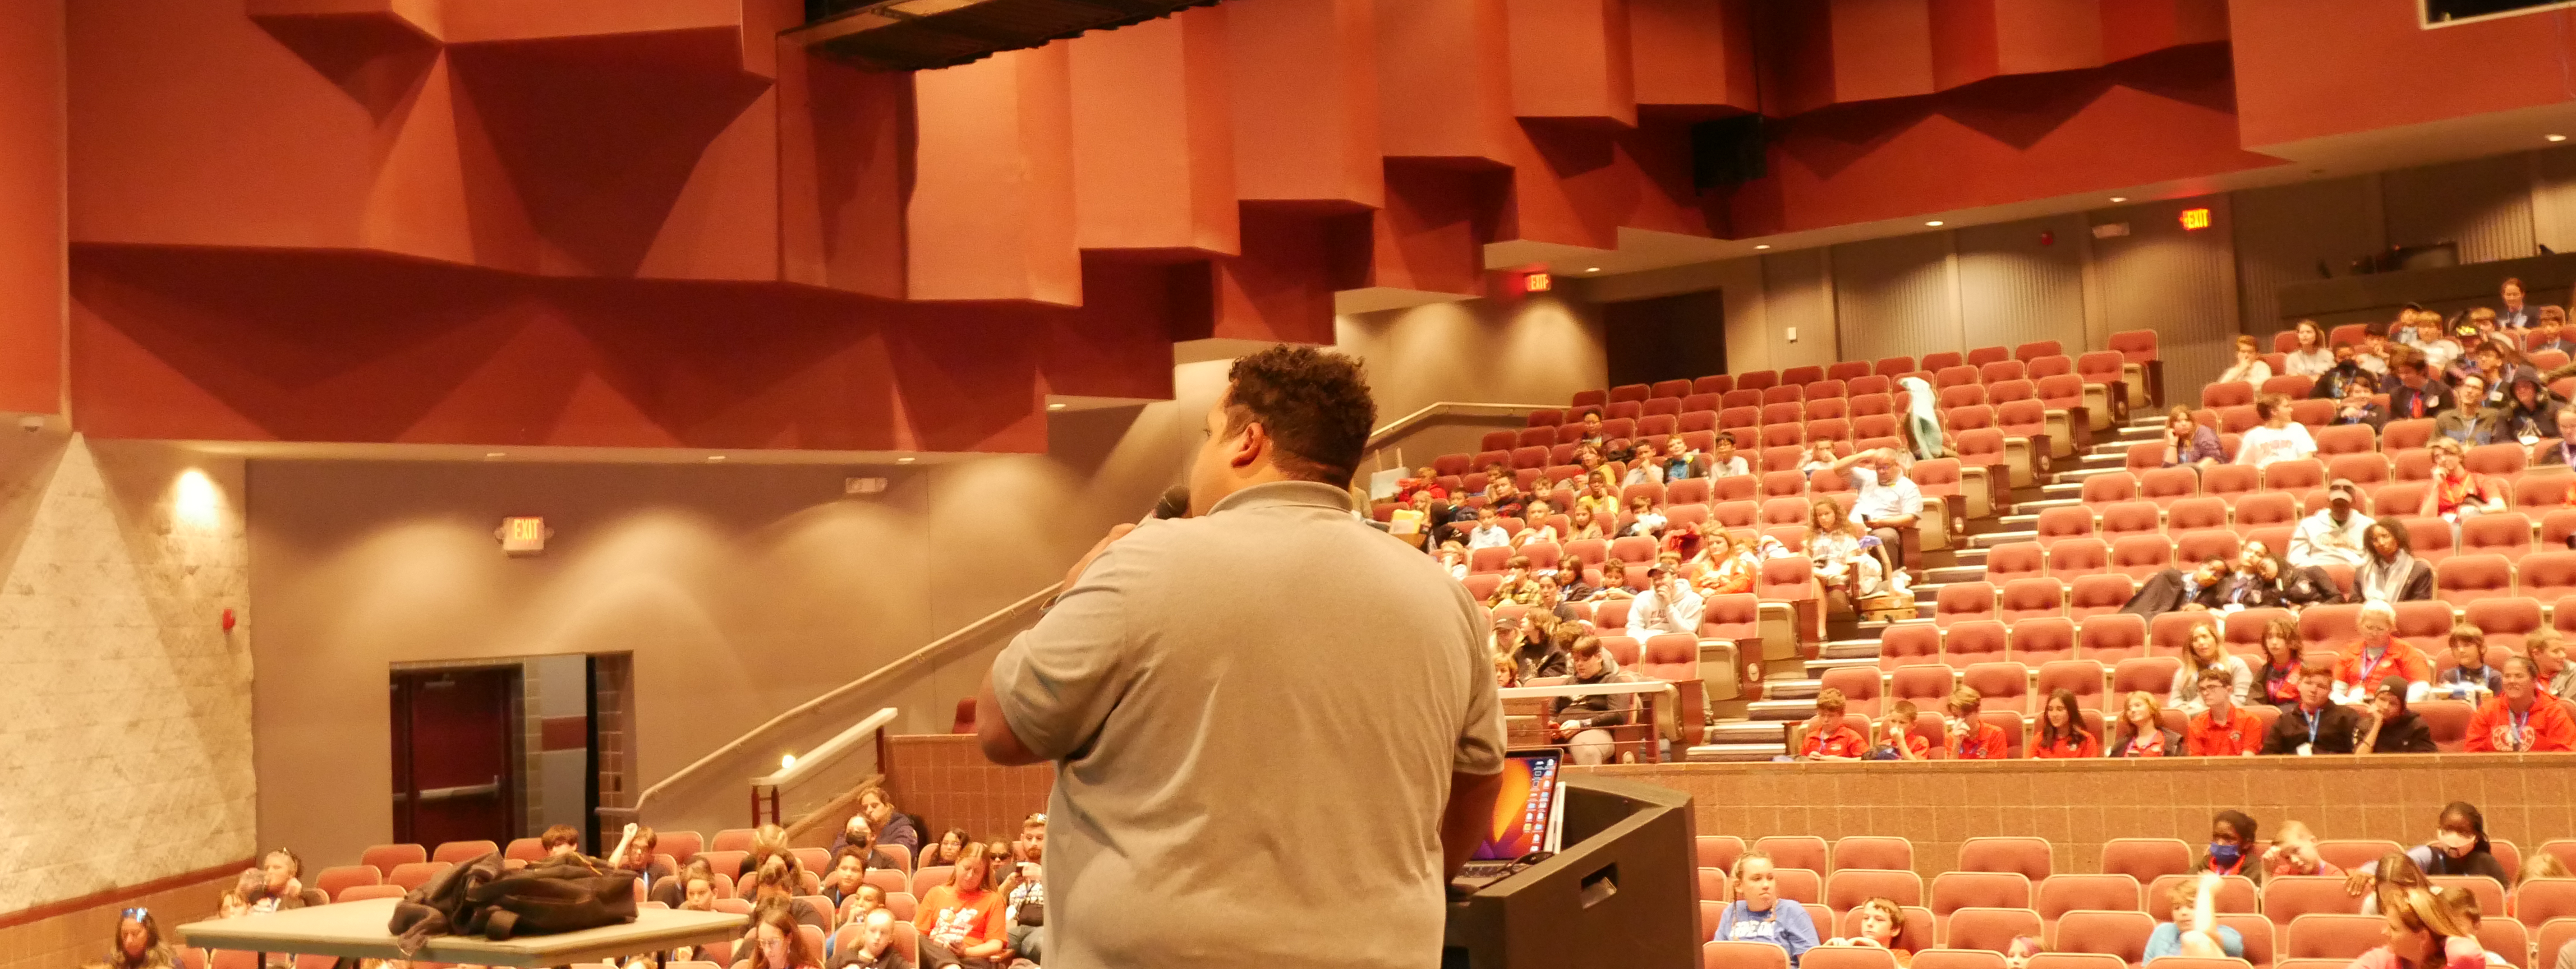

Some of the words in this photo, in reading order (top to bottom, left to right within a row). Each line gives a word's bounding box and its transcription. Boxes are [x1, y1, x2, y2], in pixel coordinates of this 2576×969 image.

[2188, 209, 2207, 228] EXIT
[1531, 274, 1547, 289] EXIT
[514, 519, 539, 539] EXIT
